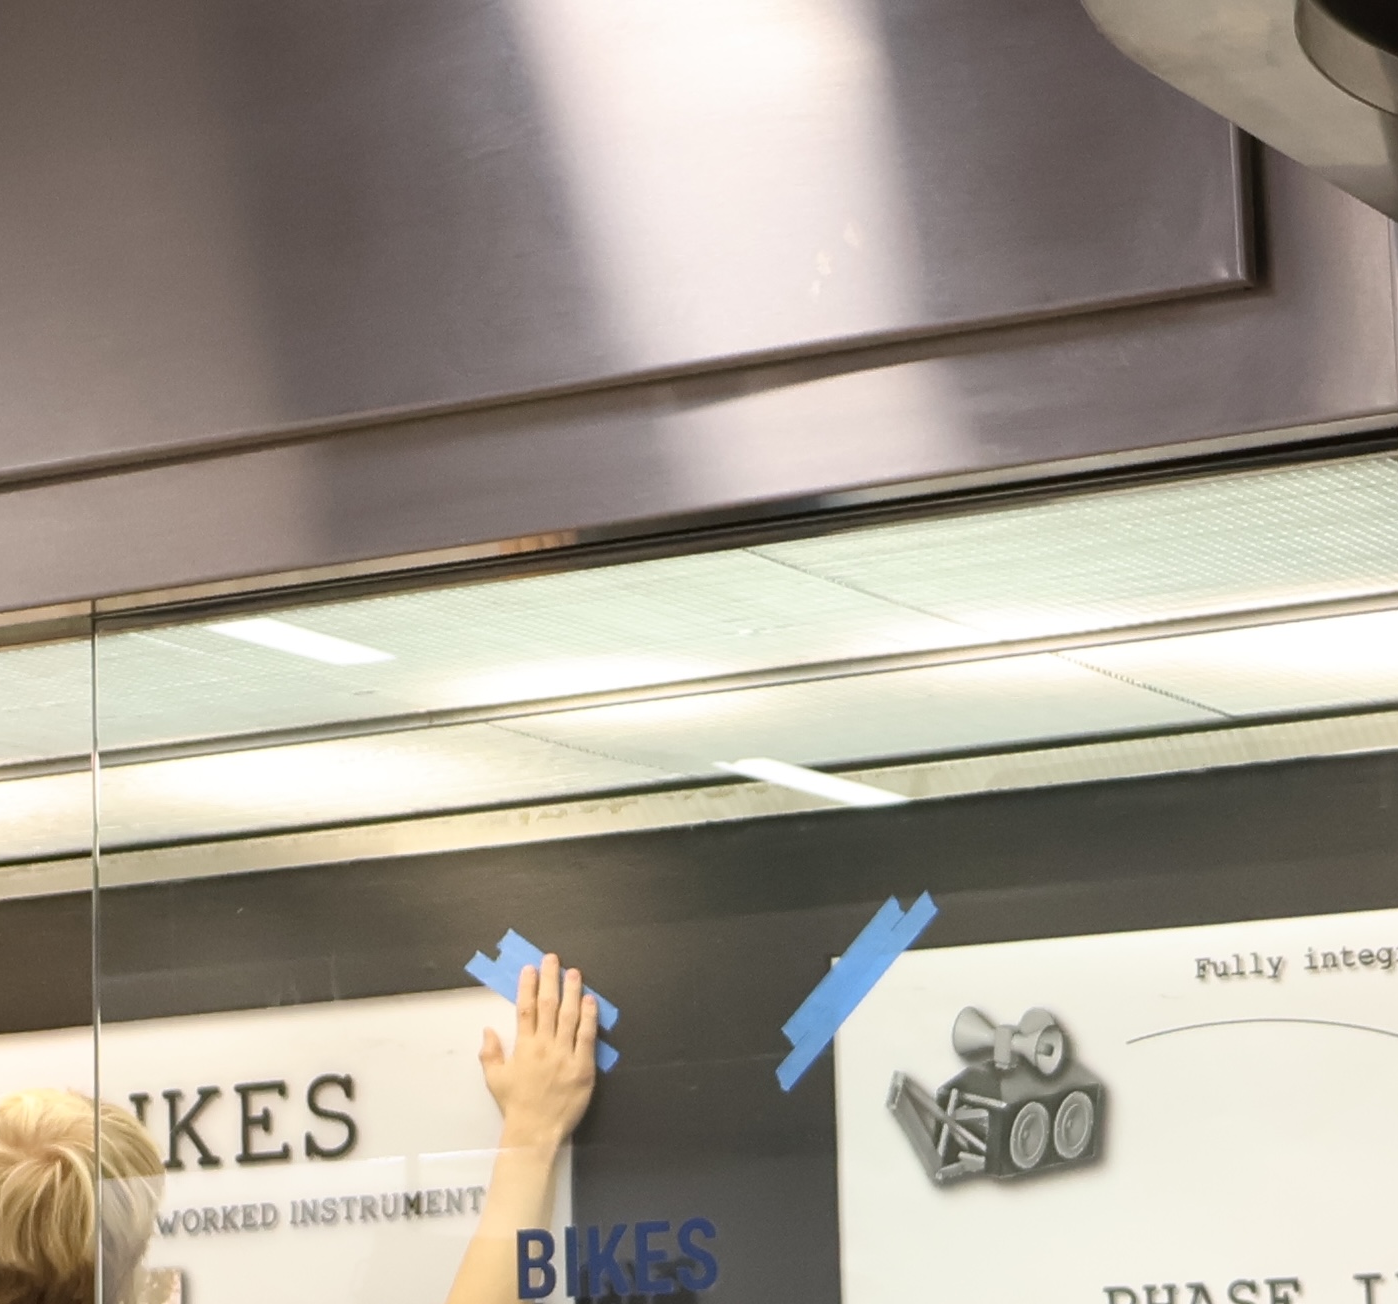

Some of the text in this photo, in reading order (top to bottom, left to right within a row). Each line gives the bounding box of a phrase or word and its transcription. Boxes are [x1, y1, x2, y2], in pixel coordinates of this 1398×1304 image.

[1194, 952, 1283, 981] Fully
[129, 1073, 357, 1170] KES
[157, 1186, 486, 1237] WORKED INSTRUMENT
[516, 1217, 719, 1300] BIKES
